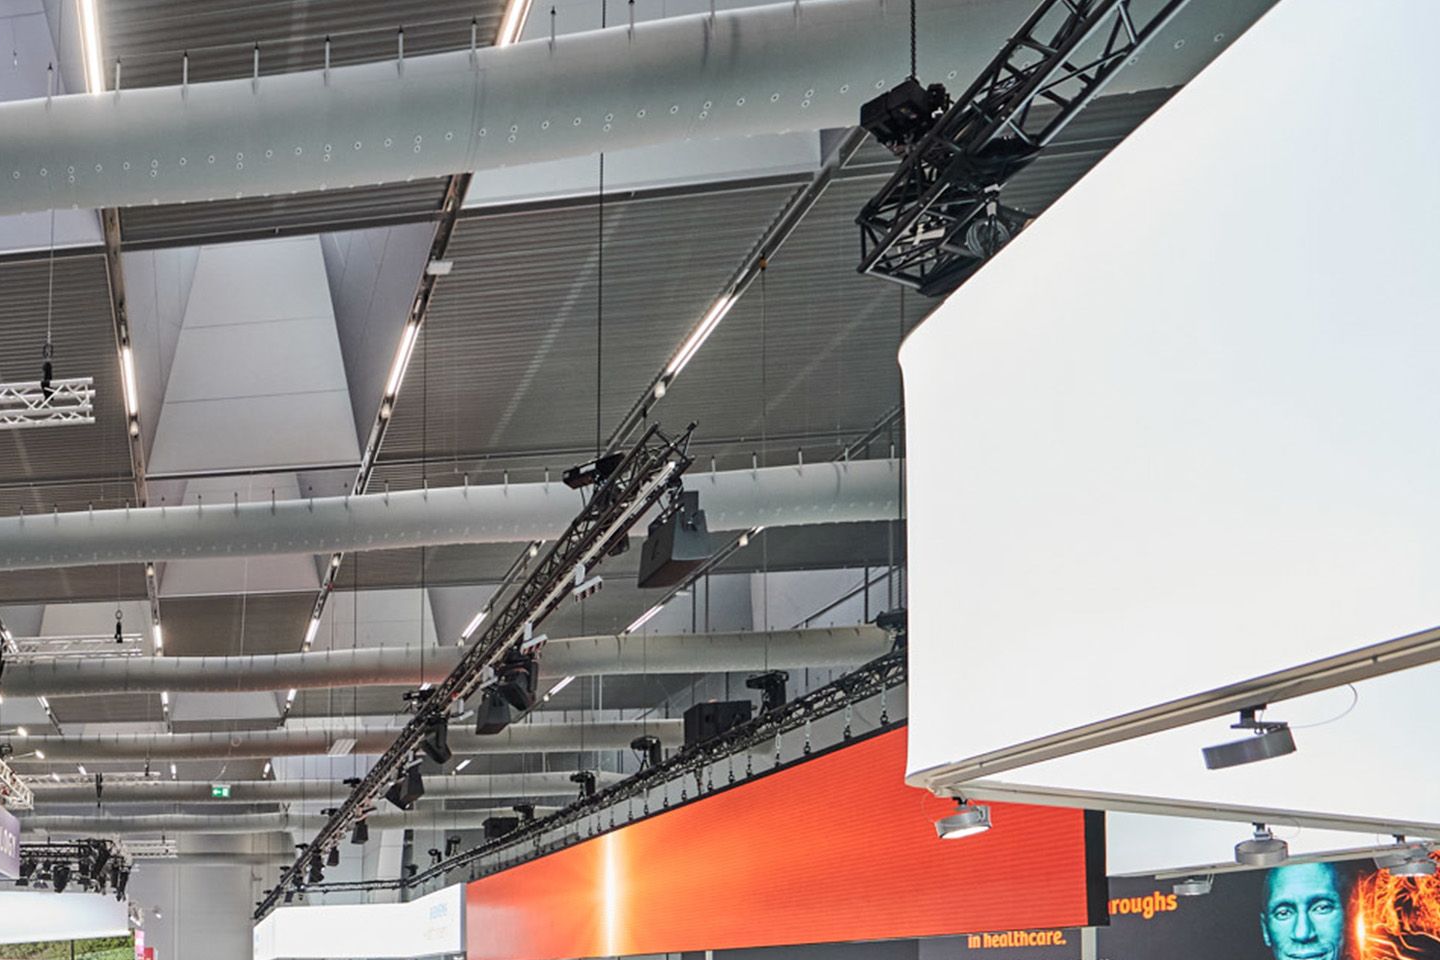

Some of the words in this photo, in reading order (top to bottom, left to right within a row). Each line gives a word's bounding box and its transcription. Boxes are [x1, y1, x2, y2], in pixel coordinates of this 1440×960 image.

[1109, 891, 1178, 919] roughs
[968, 934, 981, 949] in
[984, 930, 1067, 949] healthcare.
